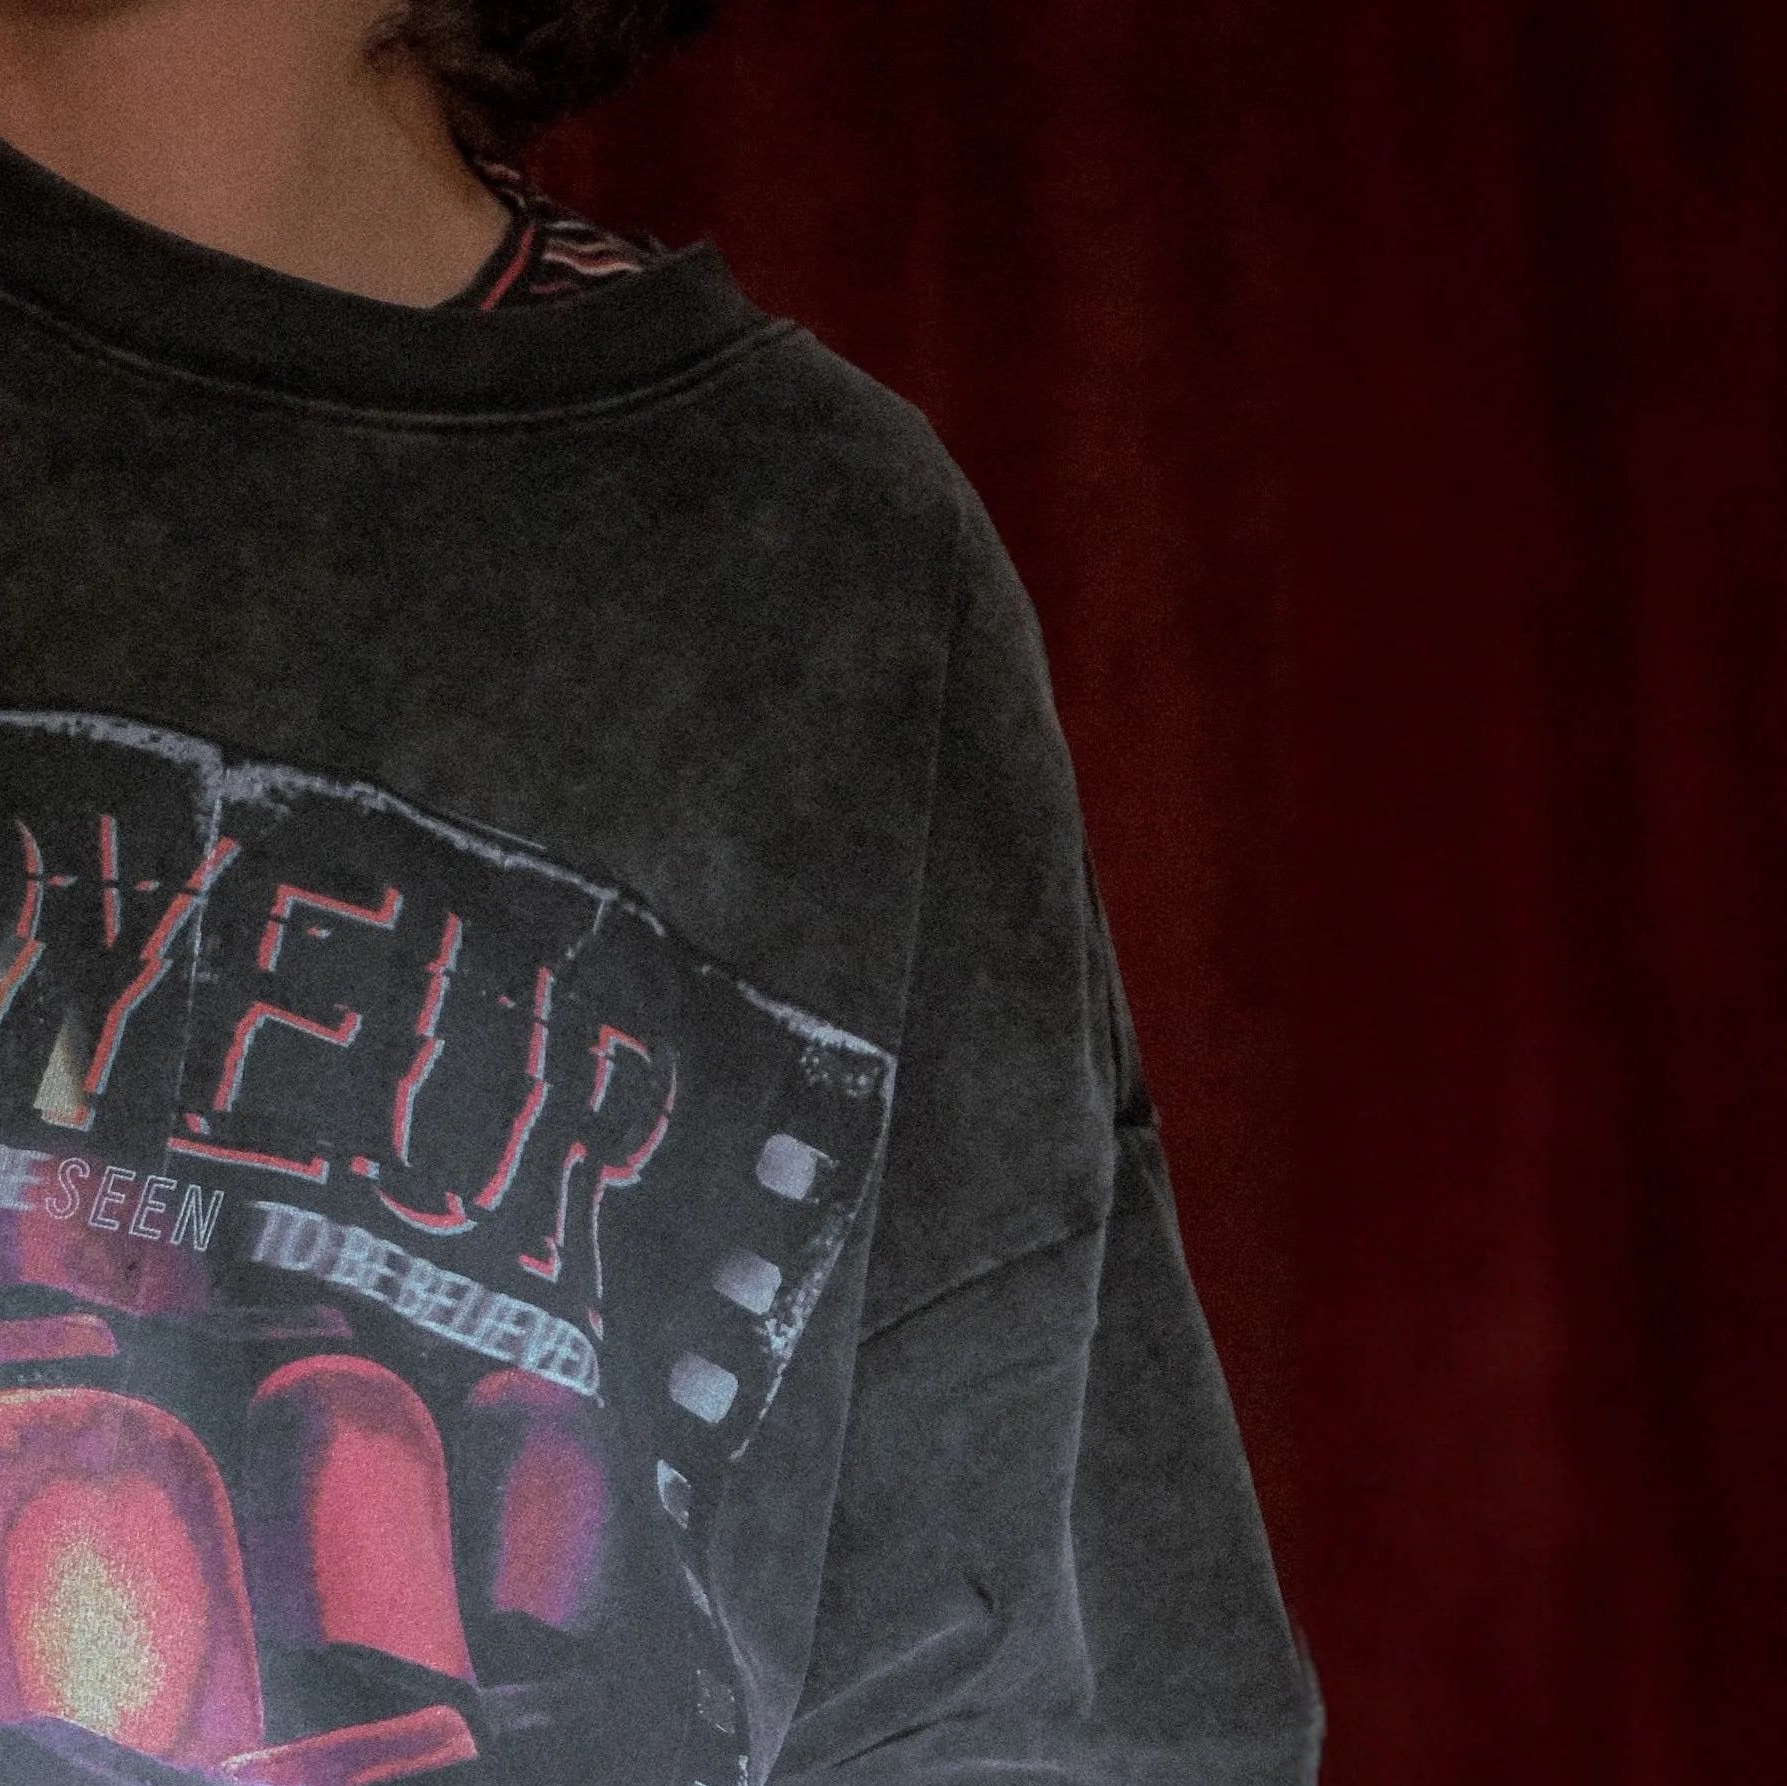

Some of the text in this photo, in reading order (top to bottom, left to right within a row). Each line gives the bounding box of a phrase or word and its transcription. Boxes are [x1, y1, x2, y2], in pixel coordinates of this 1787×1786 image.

[44, 1155, 224, 1254] SEEN
[250, 1200, 338, 1271] TO
[327, 1225, 406, 1304] BE
